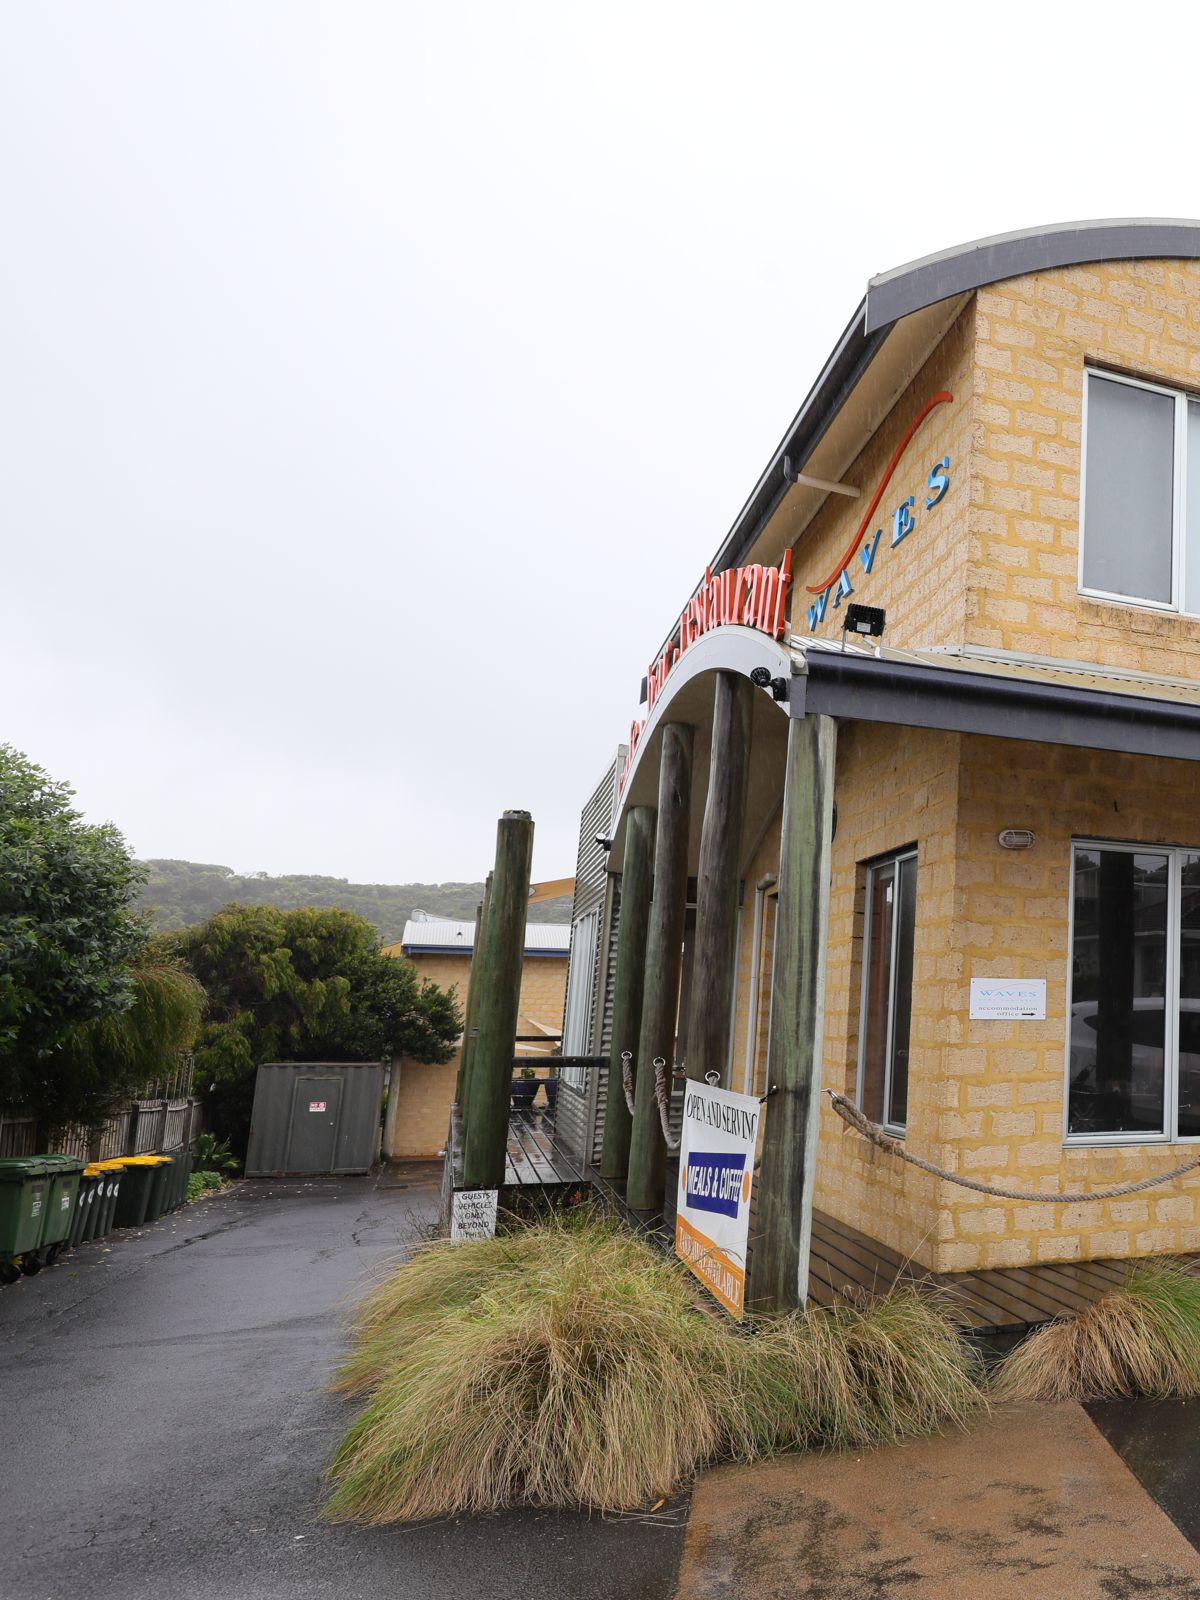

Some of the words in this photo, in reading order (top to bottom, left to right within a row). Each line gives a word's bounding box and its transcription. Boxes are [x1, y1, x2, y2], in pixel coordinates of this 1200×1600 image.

[806, 455, 950, 632] WAVES
[680, 547, 792, 642] restaurant
[686, 1093, 706, 1122] OPEN
[705, 1100, 720, 1129] AND
[722, 1104, 758, 1143] SERVING
[462, 1192, 491, 1200] GUESTS
[687, 1165, 712, 1197] MEALS
[711, 1166, 719, 1198] &
[458, 1220, 489, 1230] BEYOND
[464, 1211, 486, 1220] ONLY
